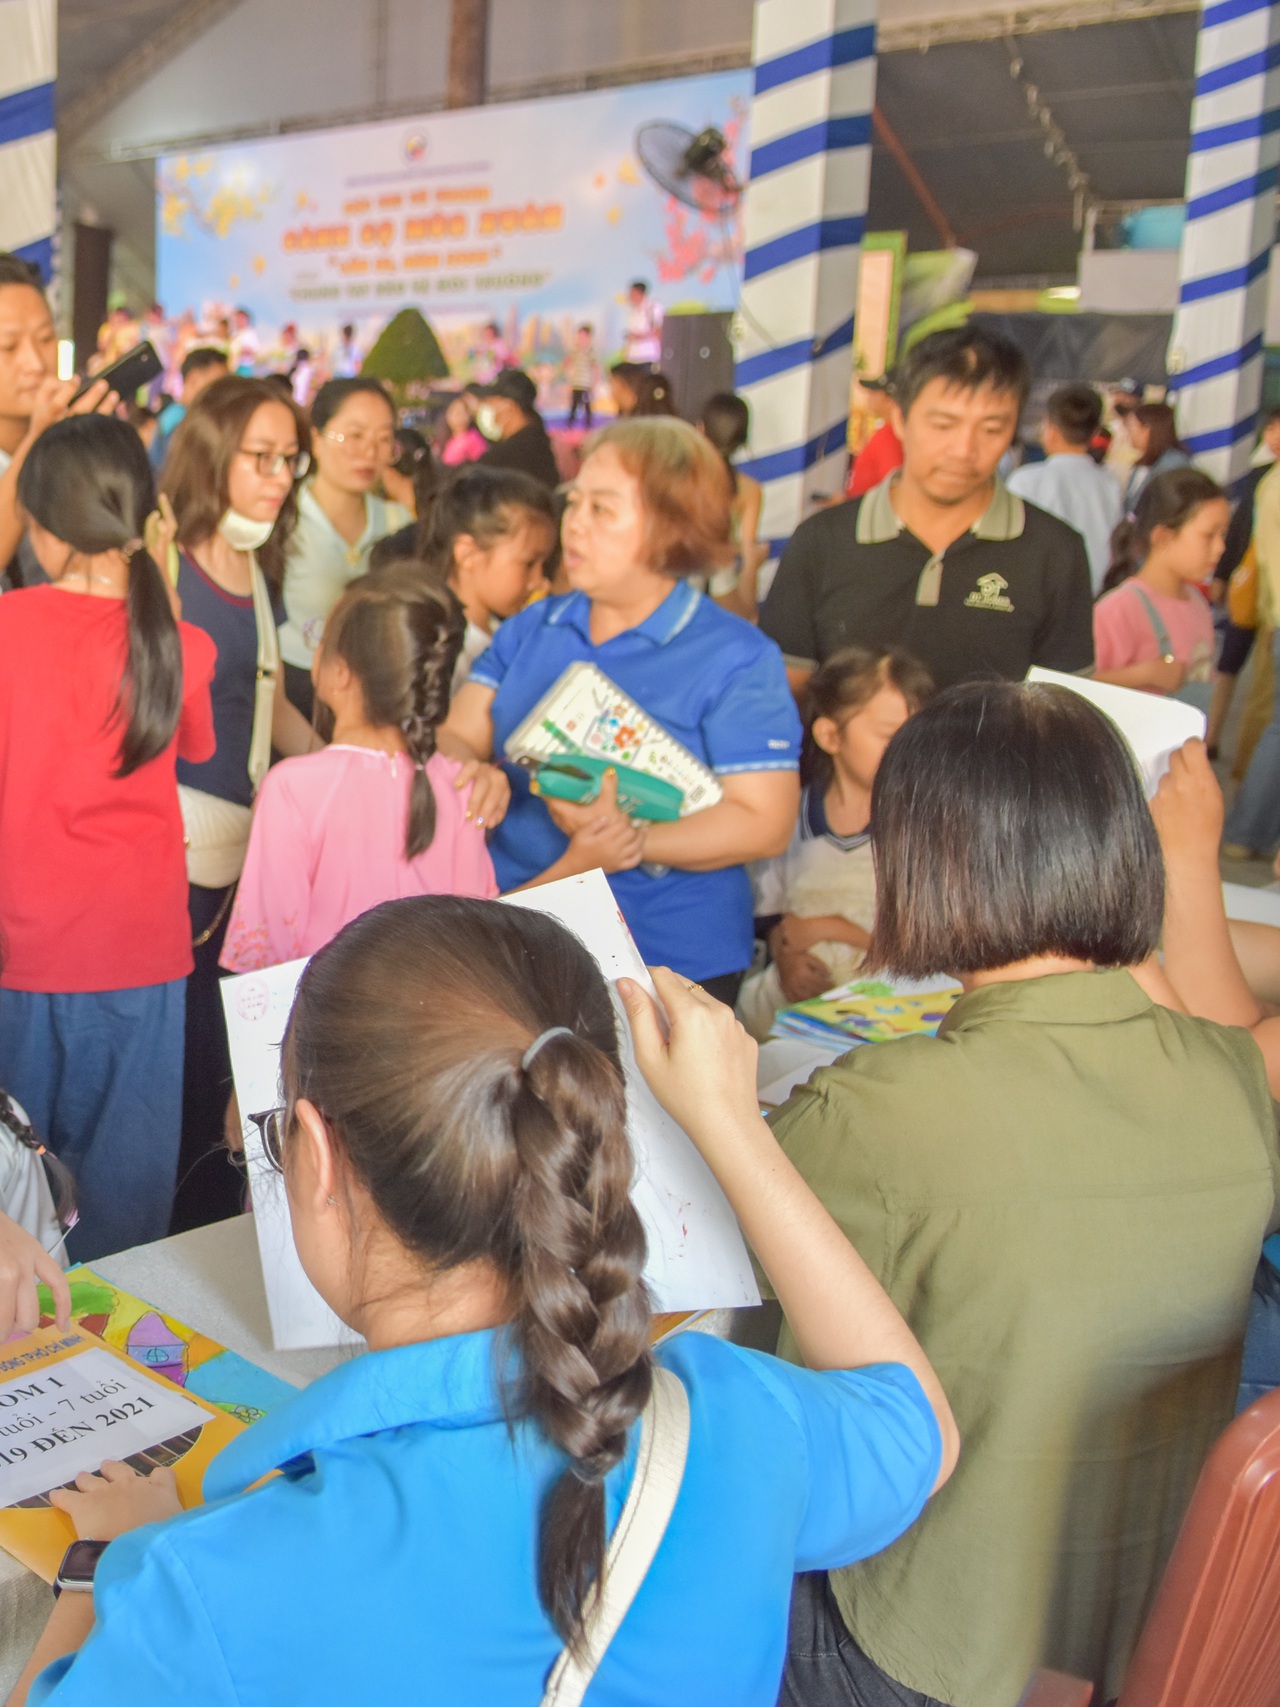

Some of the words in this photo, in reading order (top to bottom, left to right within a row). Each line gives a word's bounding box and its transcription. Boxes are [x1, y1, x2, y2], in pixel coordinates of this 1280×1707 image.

[59, 1333, 86, 1348] MINH
[57, 1399, 76, 1412] 7
[79, 1378, 129, 1404] tuổi
[30, 1420, 97, 1453] ĐẾN
[95, 1396, 157, 1427] 2021
